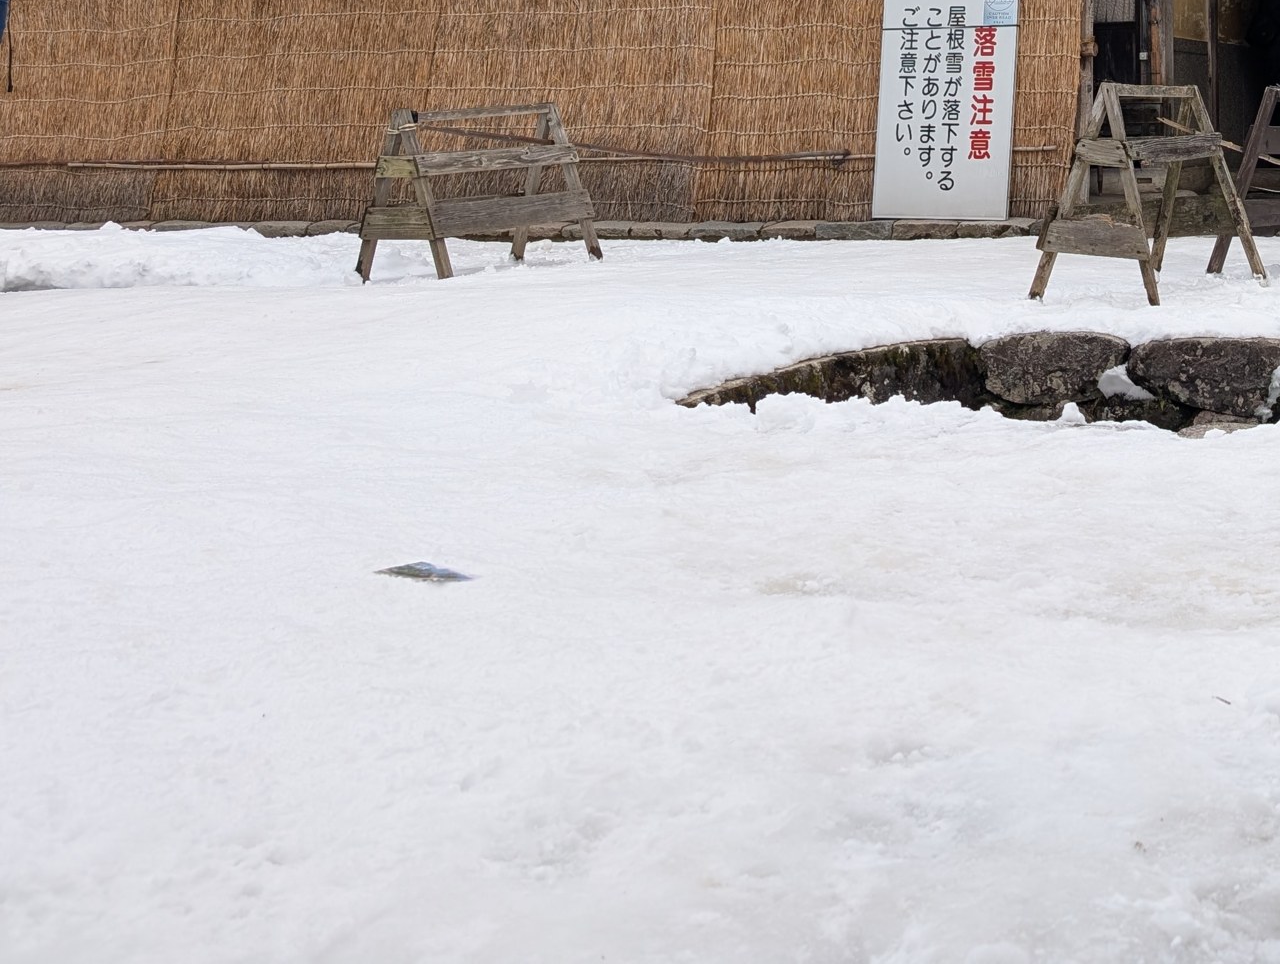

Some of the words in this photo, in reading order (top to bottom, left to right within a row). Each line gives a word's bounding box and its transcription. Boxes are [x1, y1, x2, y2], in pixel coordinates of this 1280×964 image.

[895, 6, 921, 156] ご注意下さい。
[918, 8, 942, 180] ことがあります。
[937, 6, 966, 192] 屋根雪が落下する
[968, 26, 997, 160] 落雪注意
